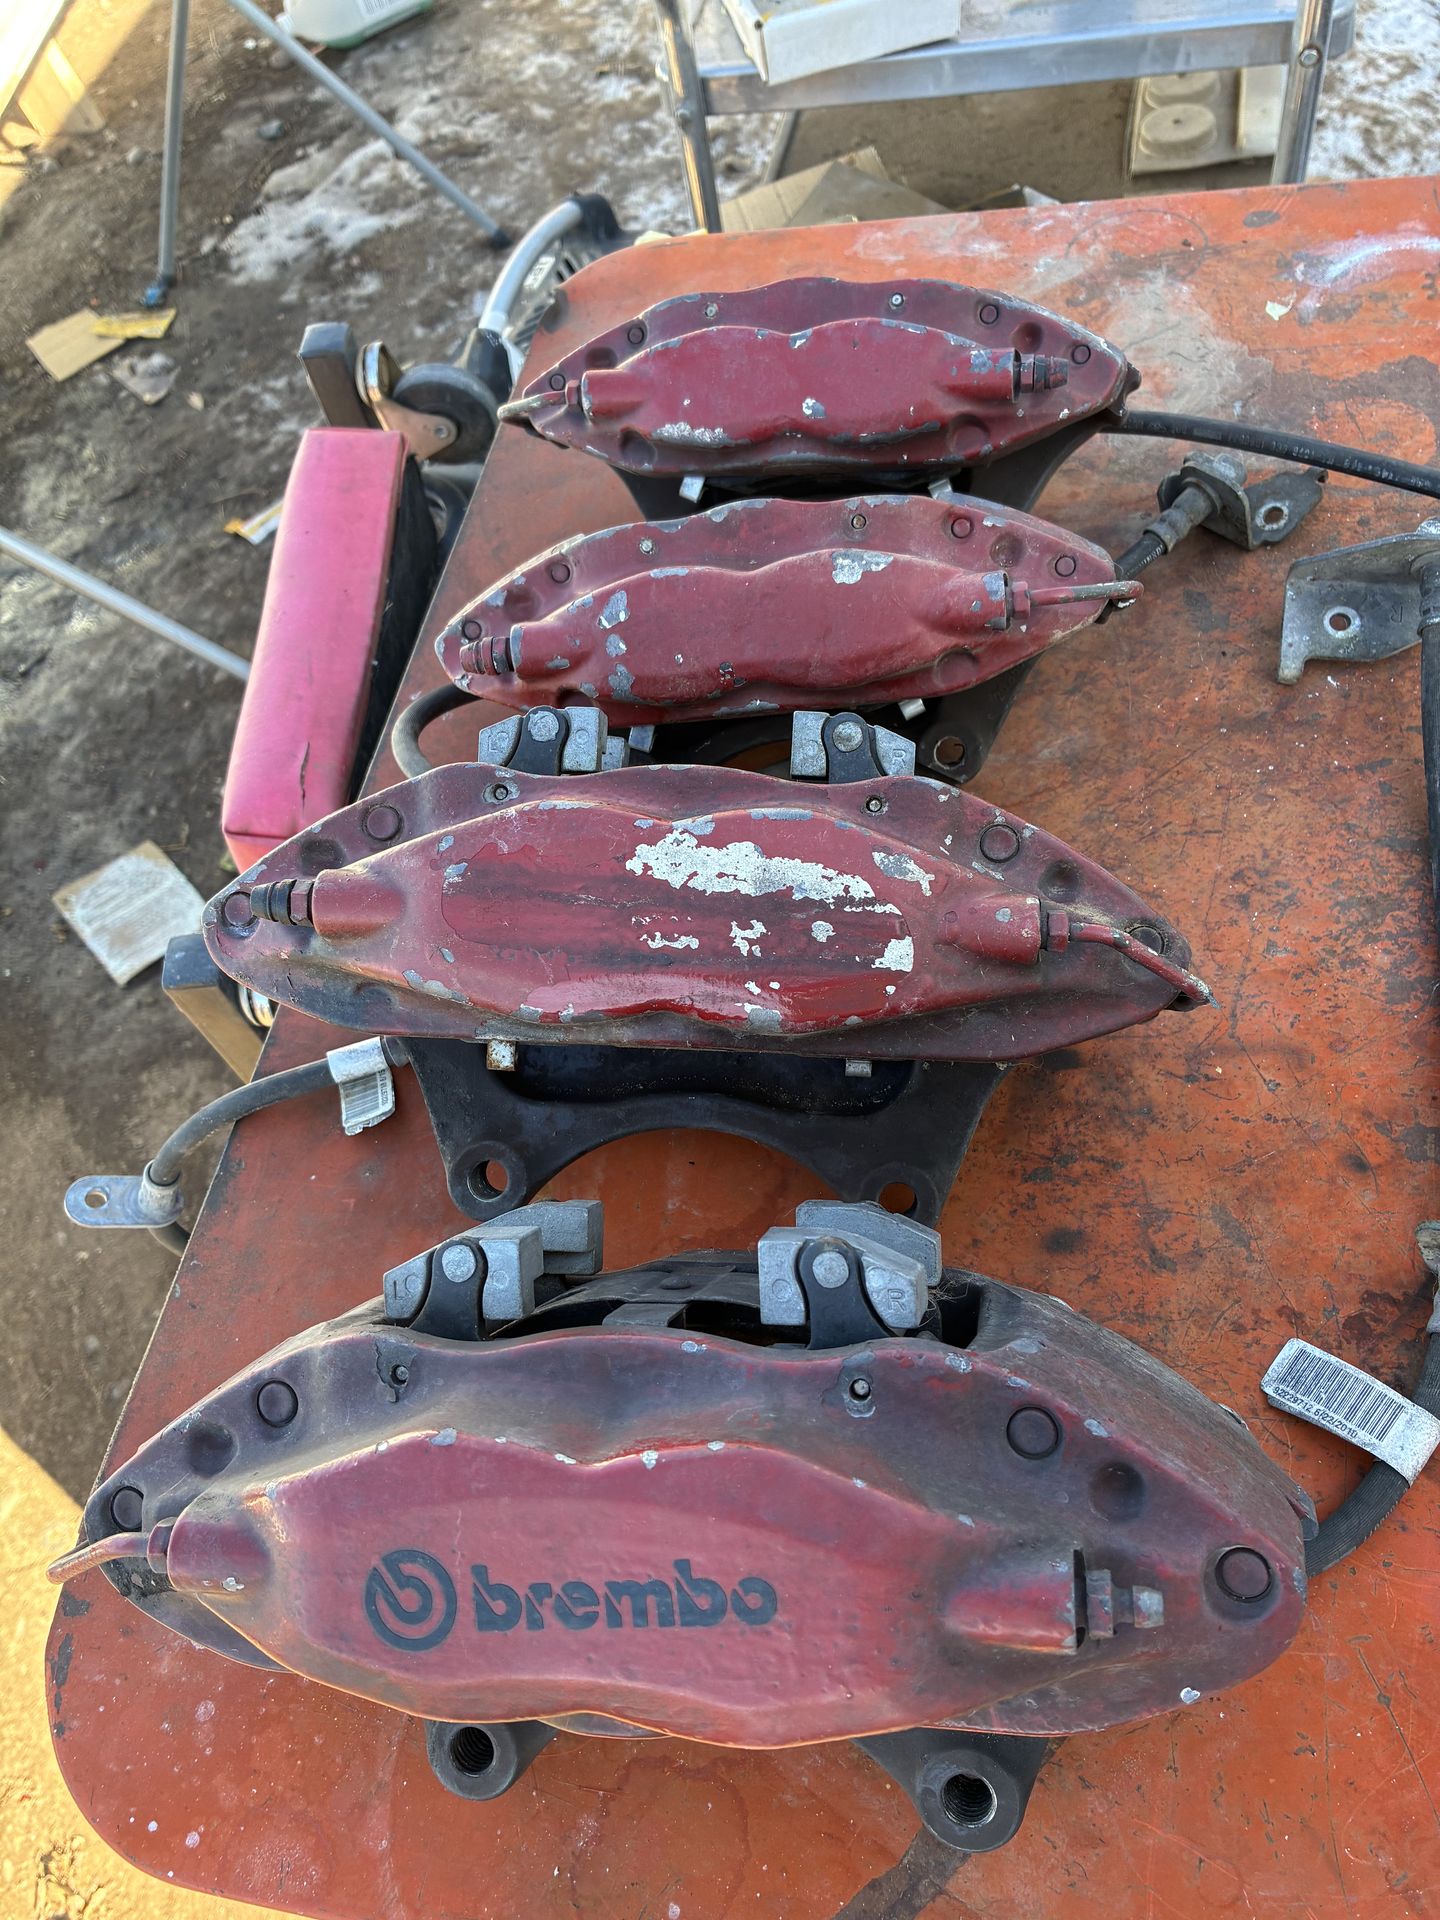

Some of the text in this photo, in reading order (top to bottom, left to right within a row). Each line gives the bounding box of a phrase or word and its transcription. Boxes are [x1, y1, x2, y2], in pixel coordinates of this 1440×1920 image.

[891, 748, 906, 767] R
[887, 1288, 907, 1312] R
[1273, 1386, 1358, 1438] 92229712 6/22/2010
[471, 1558, 778, 1632] brembo
